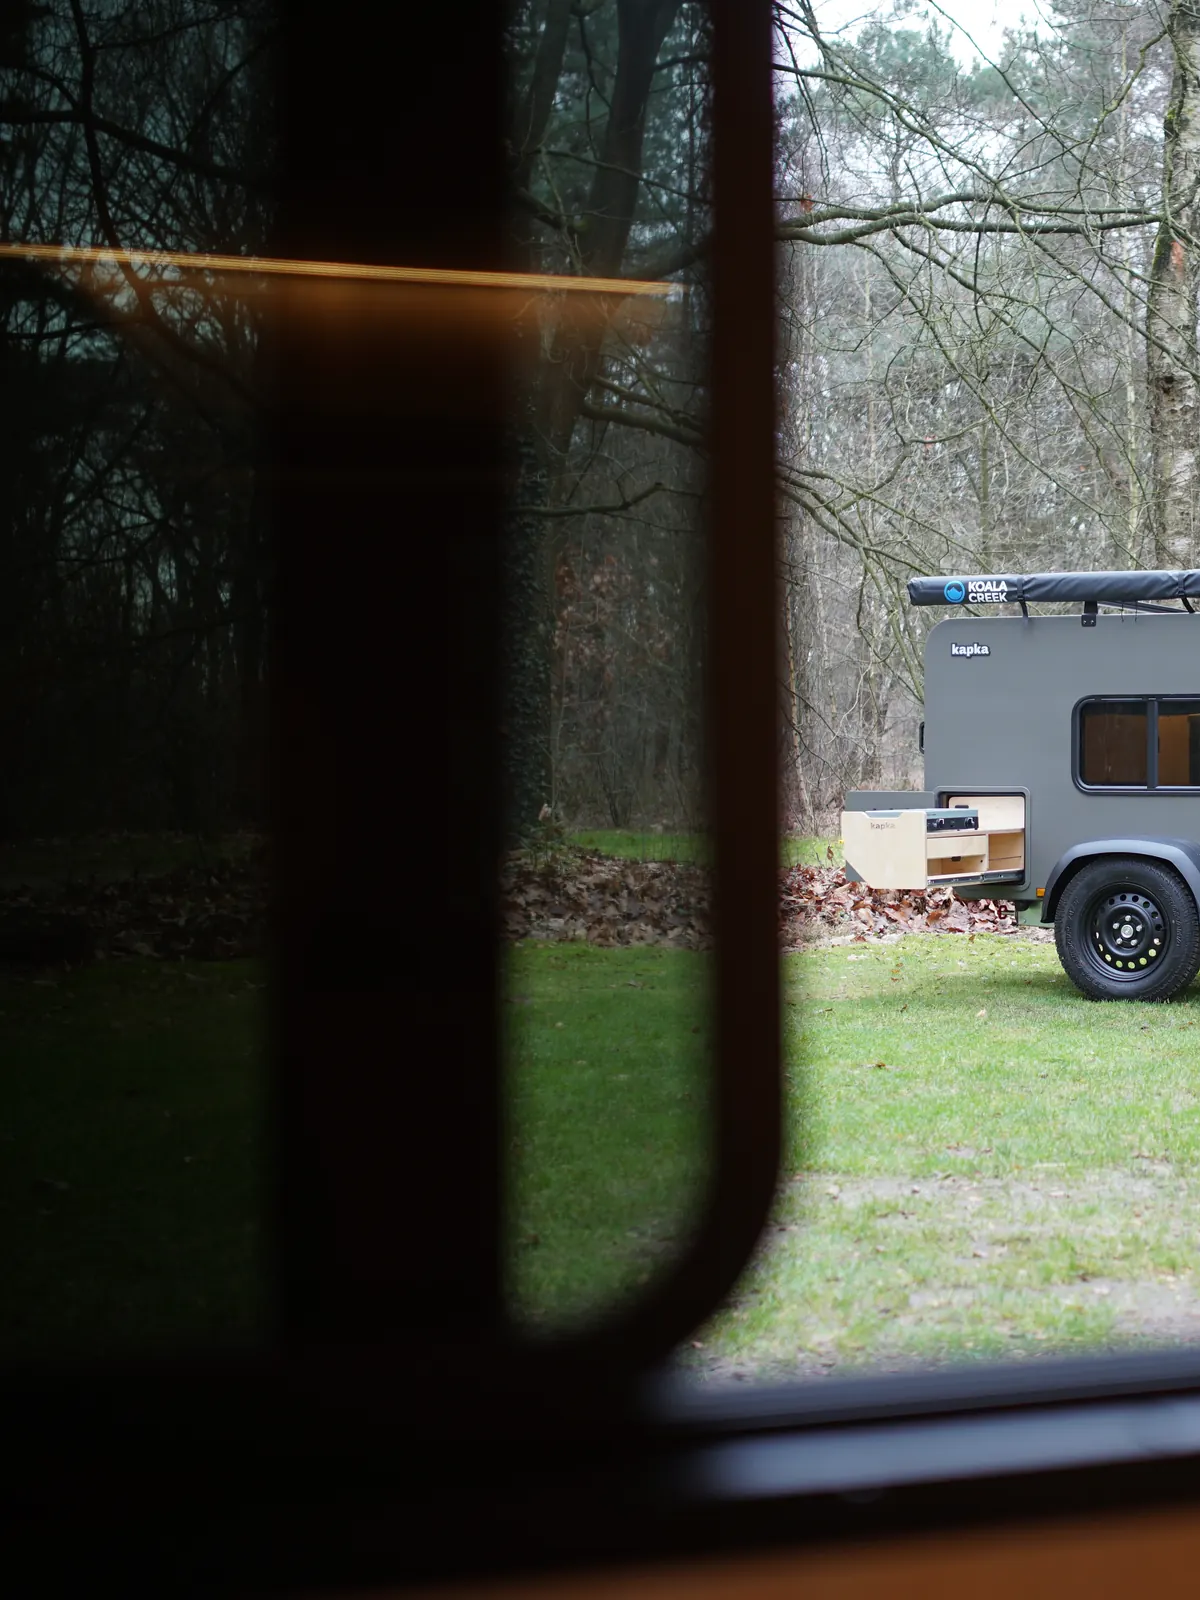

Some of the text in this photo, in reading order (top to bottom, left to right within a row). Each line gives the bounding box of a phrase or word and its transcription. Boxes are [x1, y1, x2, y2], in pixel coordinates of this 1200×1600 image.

[968, 581, 1008, 592] KOALA
[968, 592, 1008, 602] CREEK
[951, 643, 990, 657] kapka
[870, 821, 896, 830] kapka
